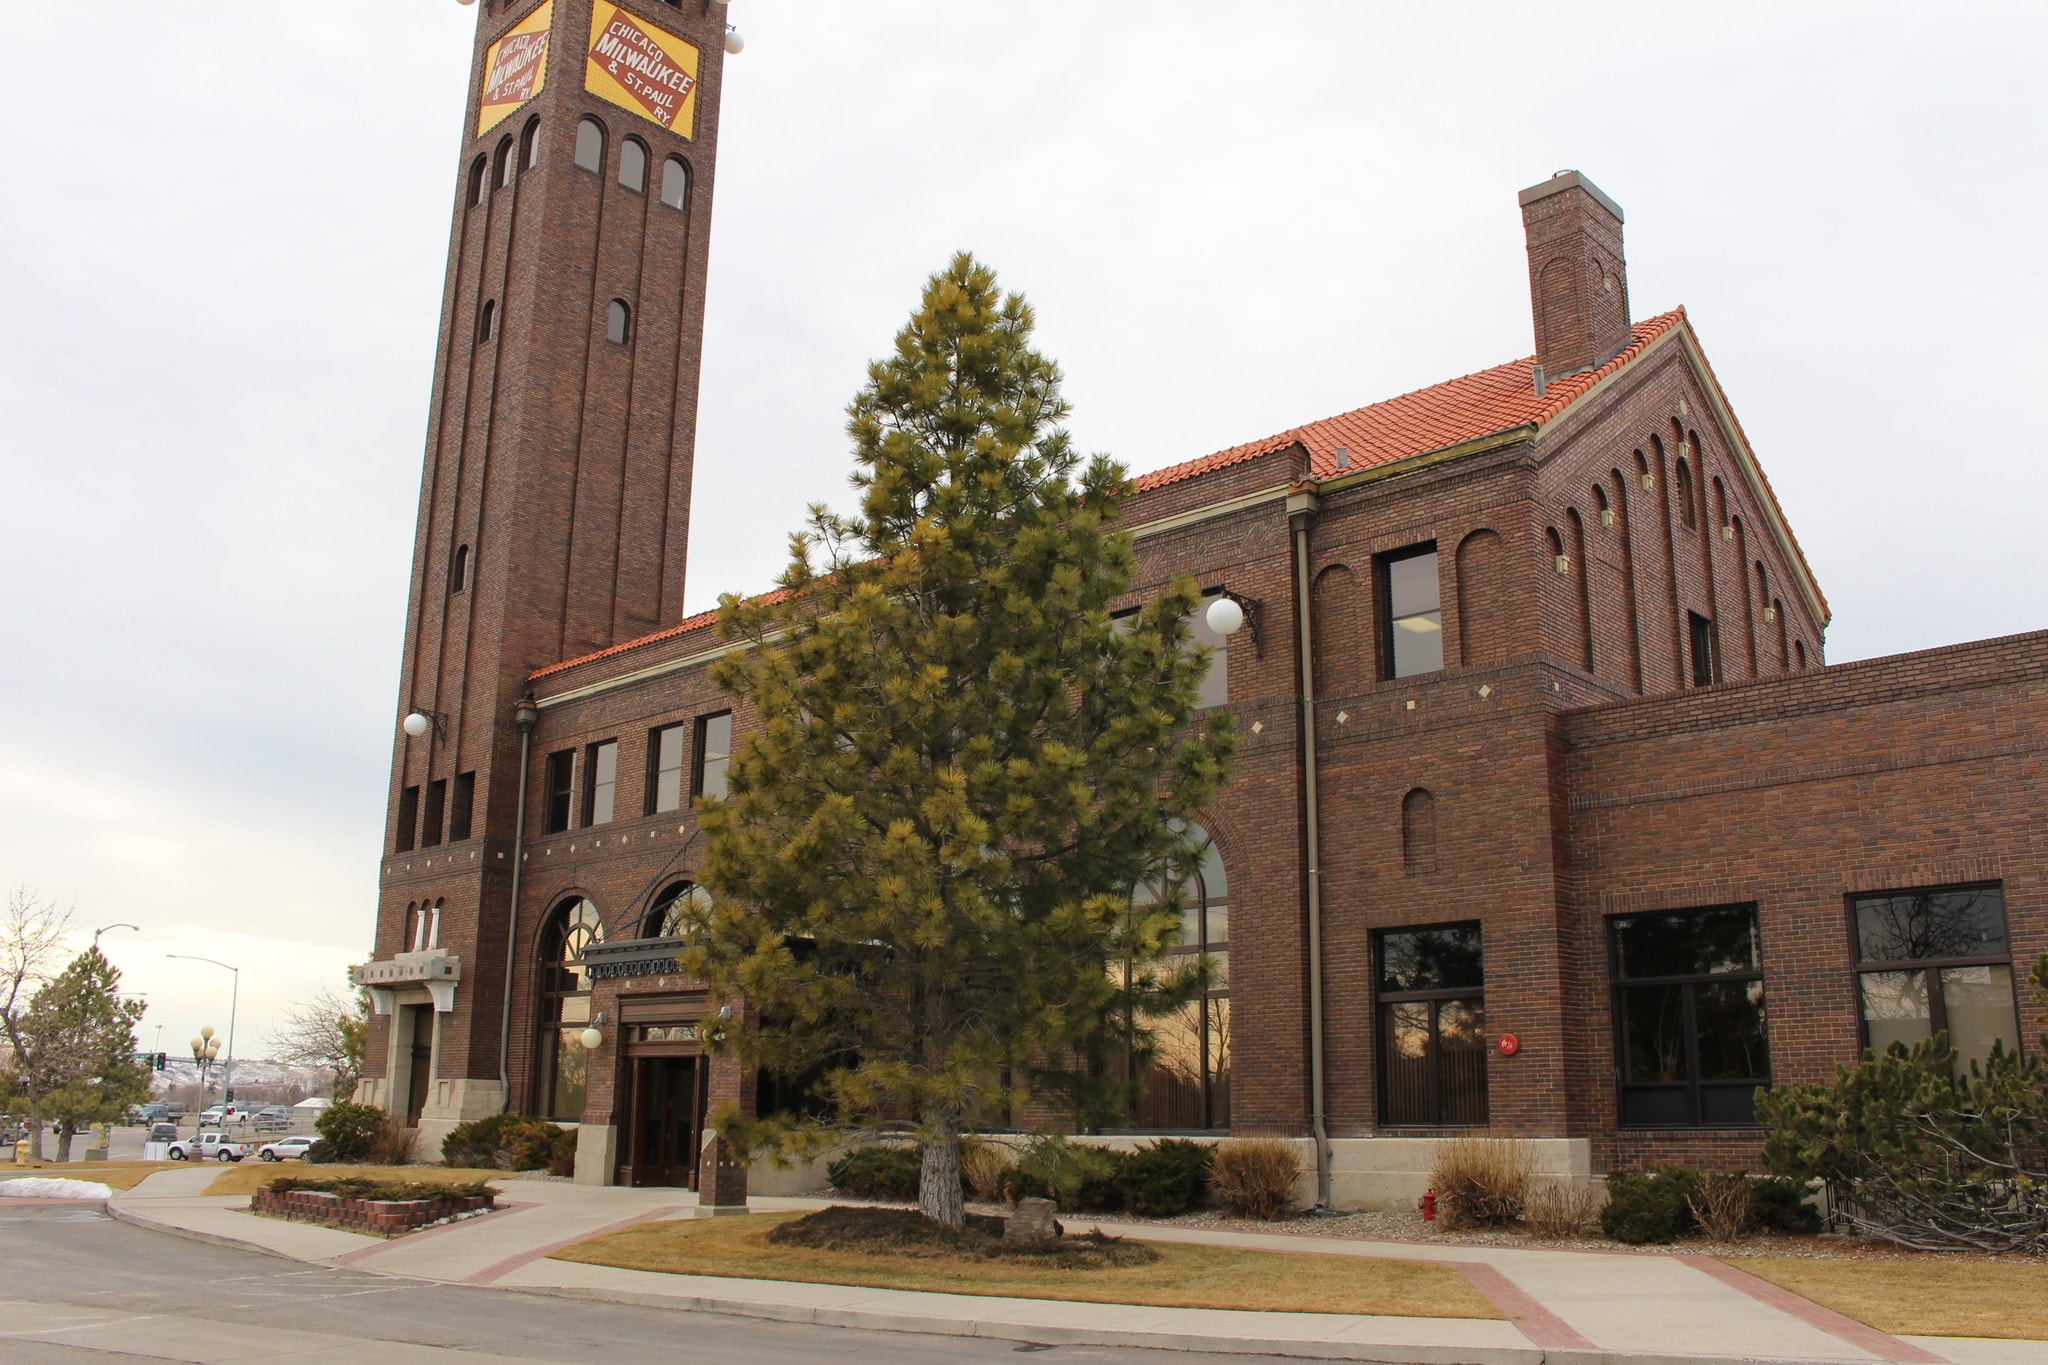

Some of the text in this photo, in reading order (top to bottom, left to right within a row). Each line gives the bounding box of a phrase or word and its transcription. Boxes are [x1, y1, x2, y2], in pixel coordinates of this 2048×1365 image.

[486, 31, 549, 95] MILWAUKEE
[595, 32, 694, 94] MILWAUKEE
[607, 60, 618, 76] &
[653, 105, 671, 127] RY.
